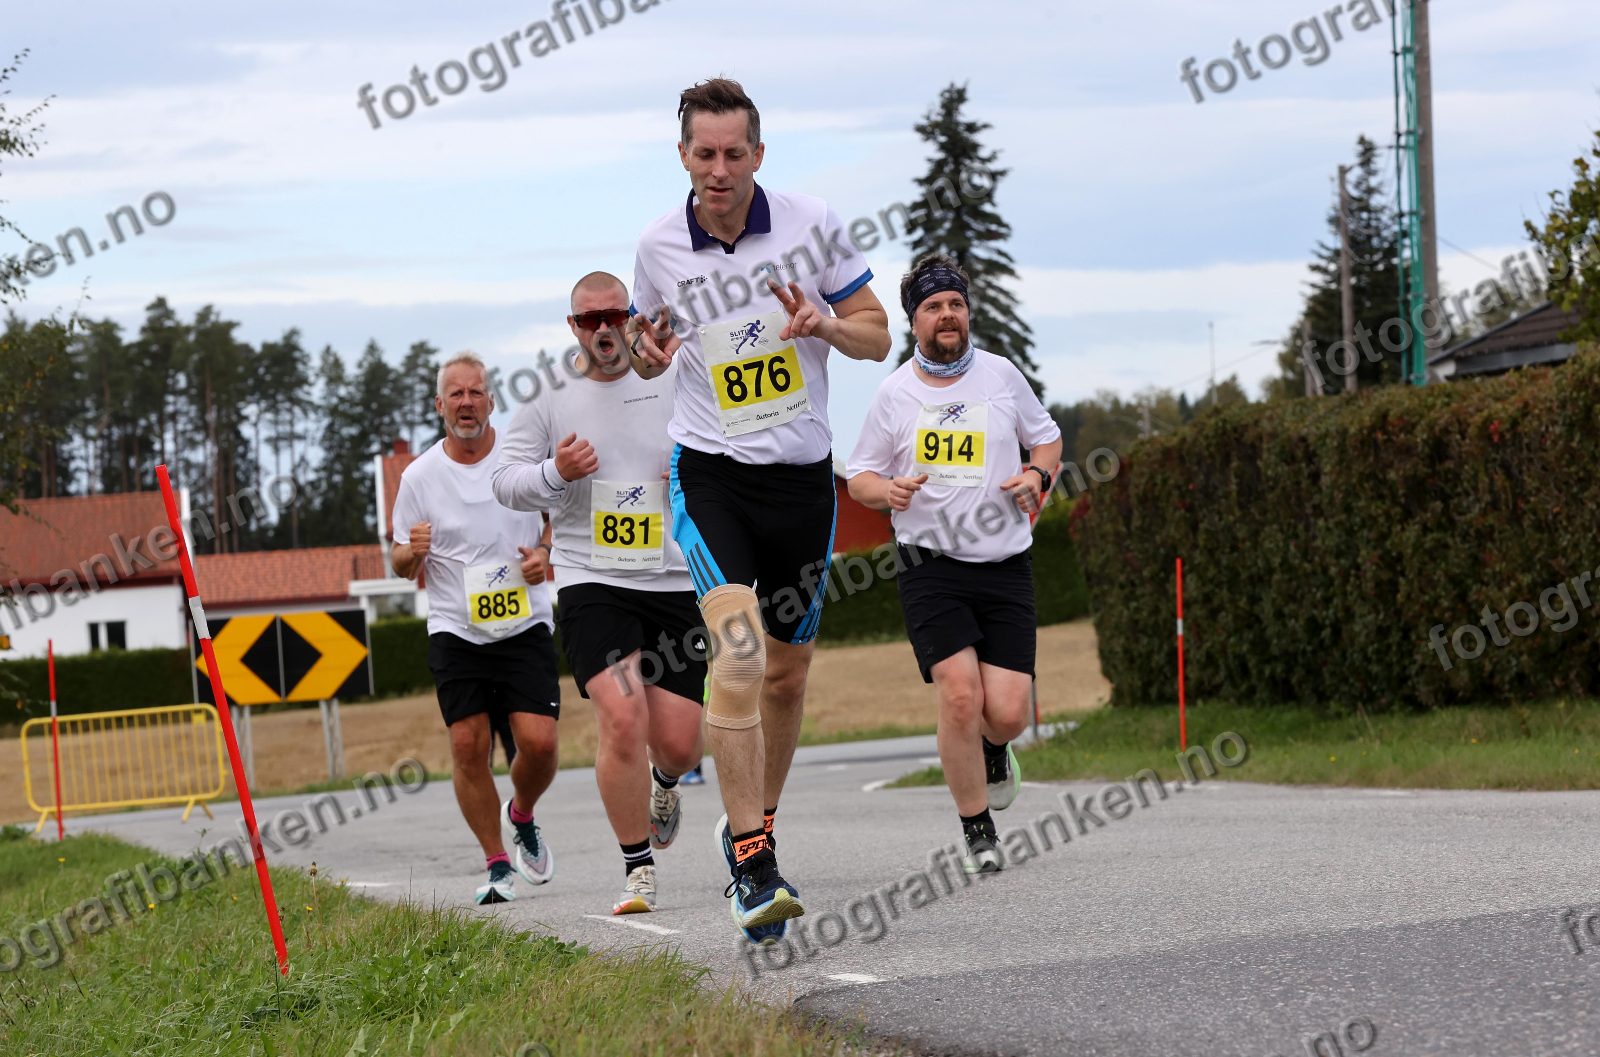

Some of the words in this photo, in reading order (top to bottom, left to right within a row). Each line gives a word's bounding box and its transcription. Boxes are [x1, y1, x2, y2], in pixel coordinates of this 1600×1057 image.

[677, 276, 700, 288] CRAFT
[723, 355, 791, 403] 876
[923, 432, 974, 463] 914
[602, 515, 650, 545] 831
[478, 591, 520, 619] 885
